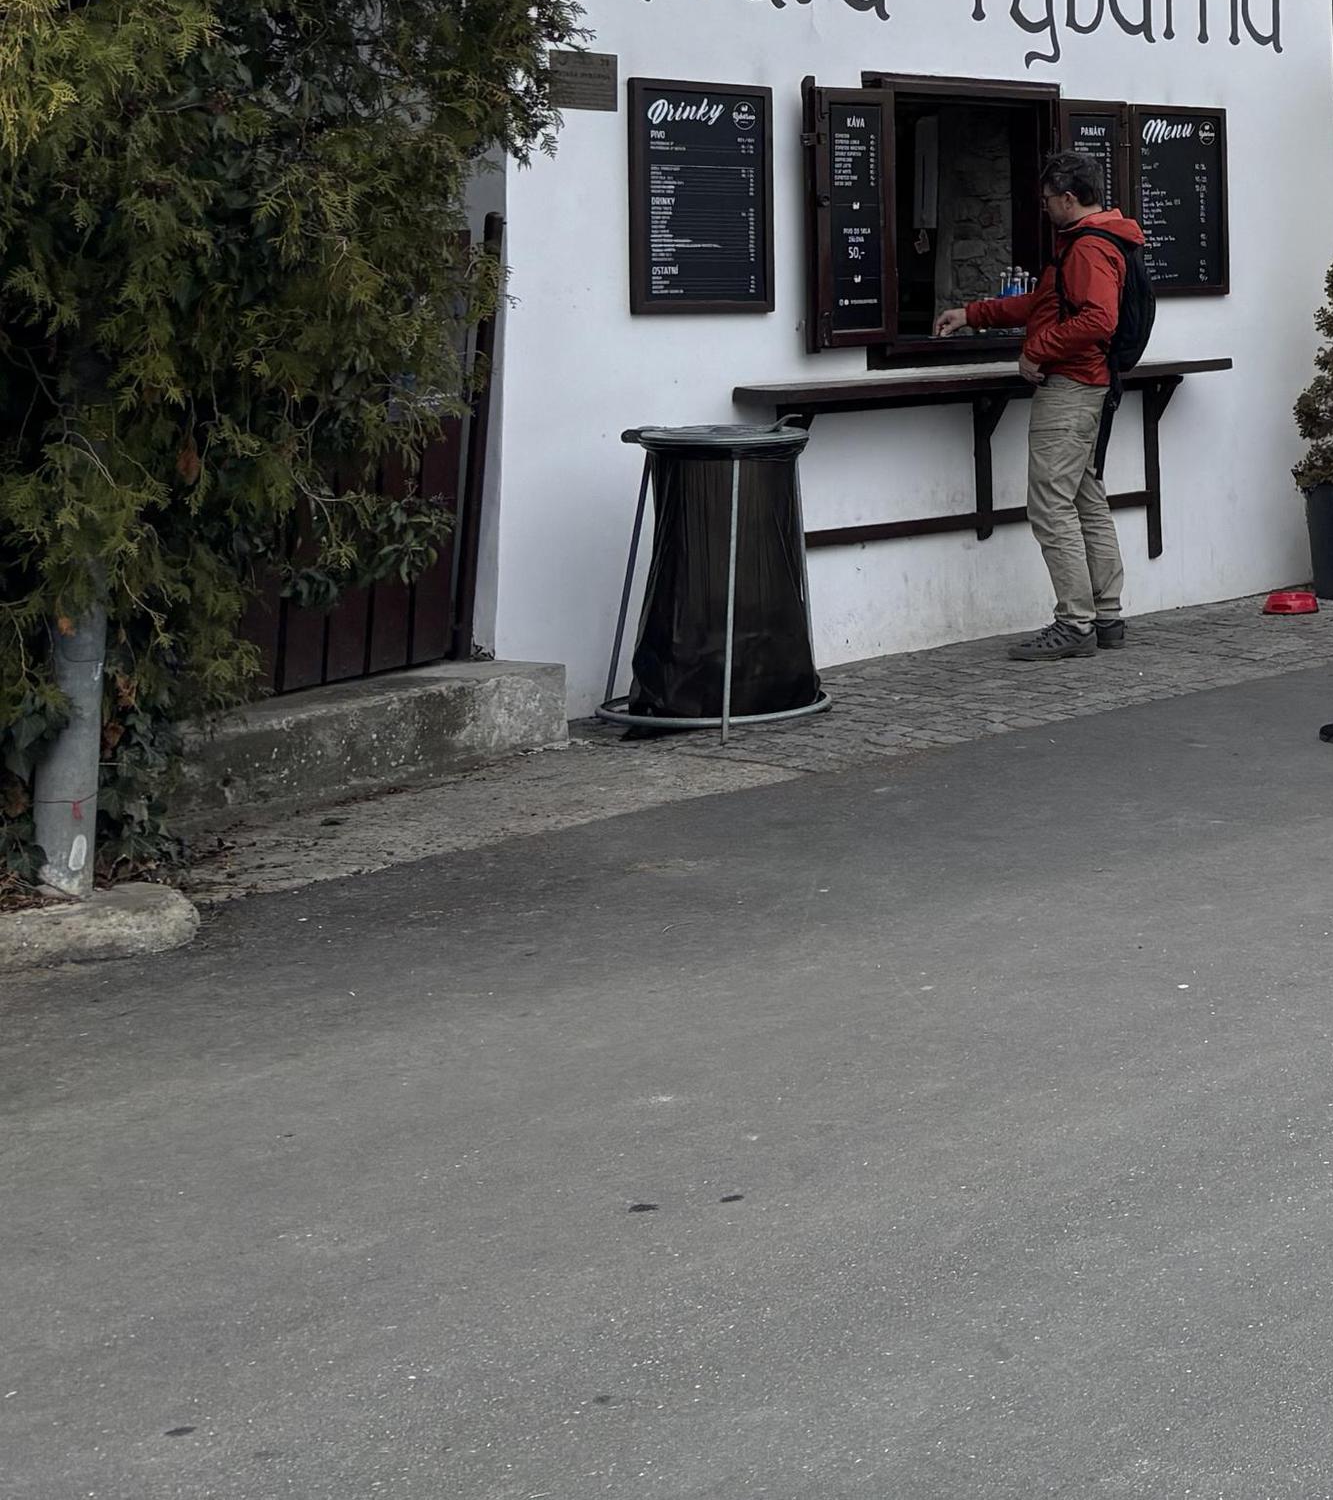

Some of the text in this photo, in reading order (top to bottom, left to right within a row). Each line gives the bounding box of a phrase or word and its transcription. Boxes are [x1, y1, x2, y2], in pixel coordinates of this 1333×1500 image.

[647, 98, 725, 126] Drinky
[846, 115, 865, 128] KÁVA
[1142, 119, 1195, 145] Menu
